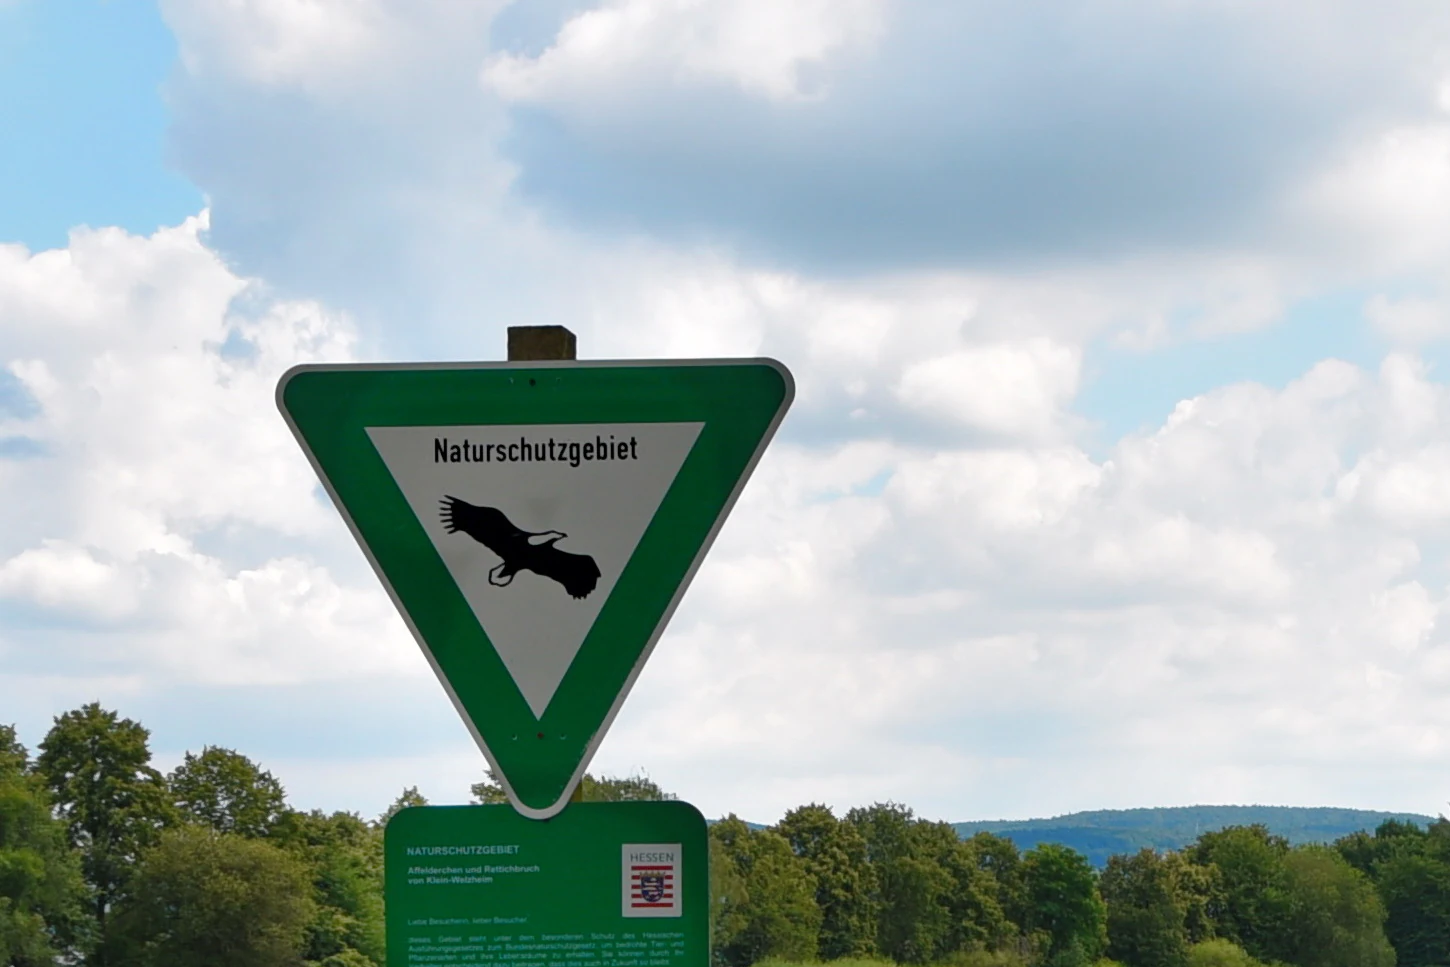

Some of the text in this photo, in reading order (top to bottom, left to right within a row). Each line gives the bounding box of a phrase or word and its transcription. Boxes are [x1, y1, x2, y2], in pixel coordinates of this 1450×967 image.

[434, 435, 638, 468] Naturschutzgebiet
[407, 845, 520, 856] NATURSCHUTZGEBIET
[630, 852, 674, 863] HESSEN
[465, 866, 482, 874] und
[408, 877, 425, 885] von
